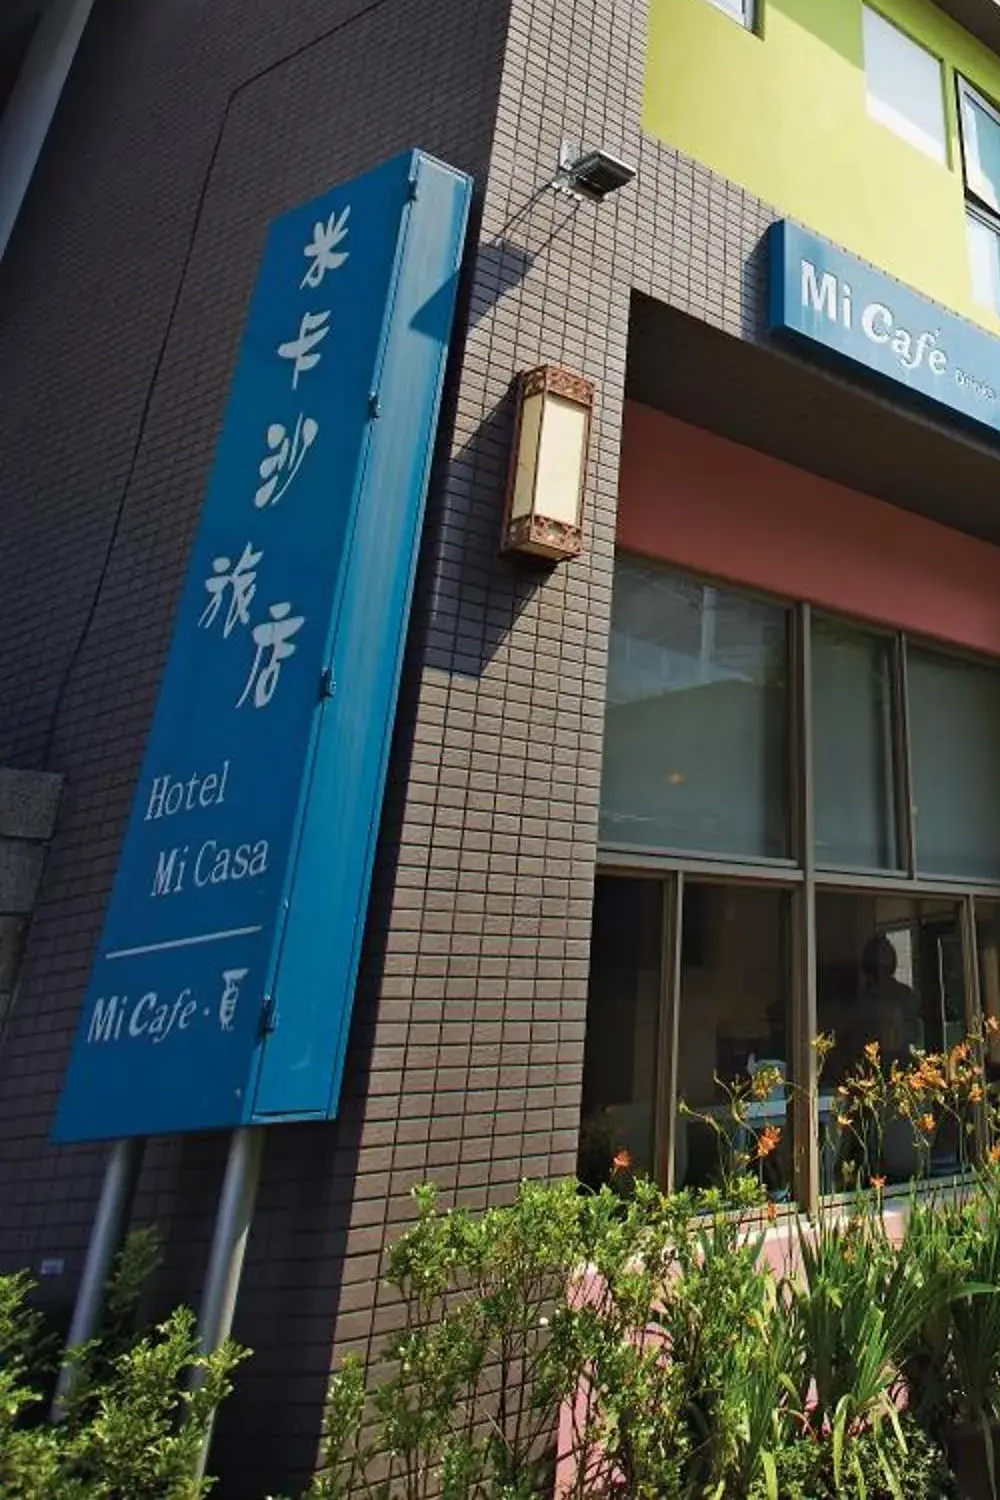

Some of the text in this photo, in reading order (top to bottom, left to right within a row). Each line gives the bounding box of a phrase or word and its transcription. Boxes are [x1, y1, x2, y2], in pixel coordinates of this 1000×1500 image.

[801, 260, 853, 330] Mi
[144, 760, 230, 821] Hotel
[150, 839, 269, 897] Mi Casa
[87, 996, 128, 1044] Mi
